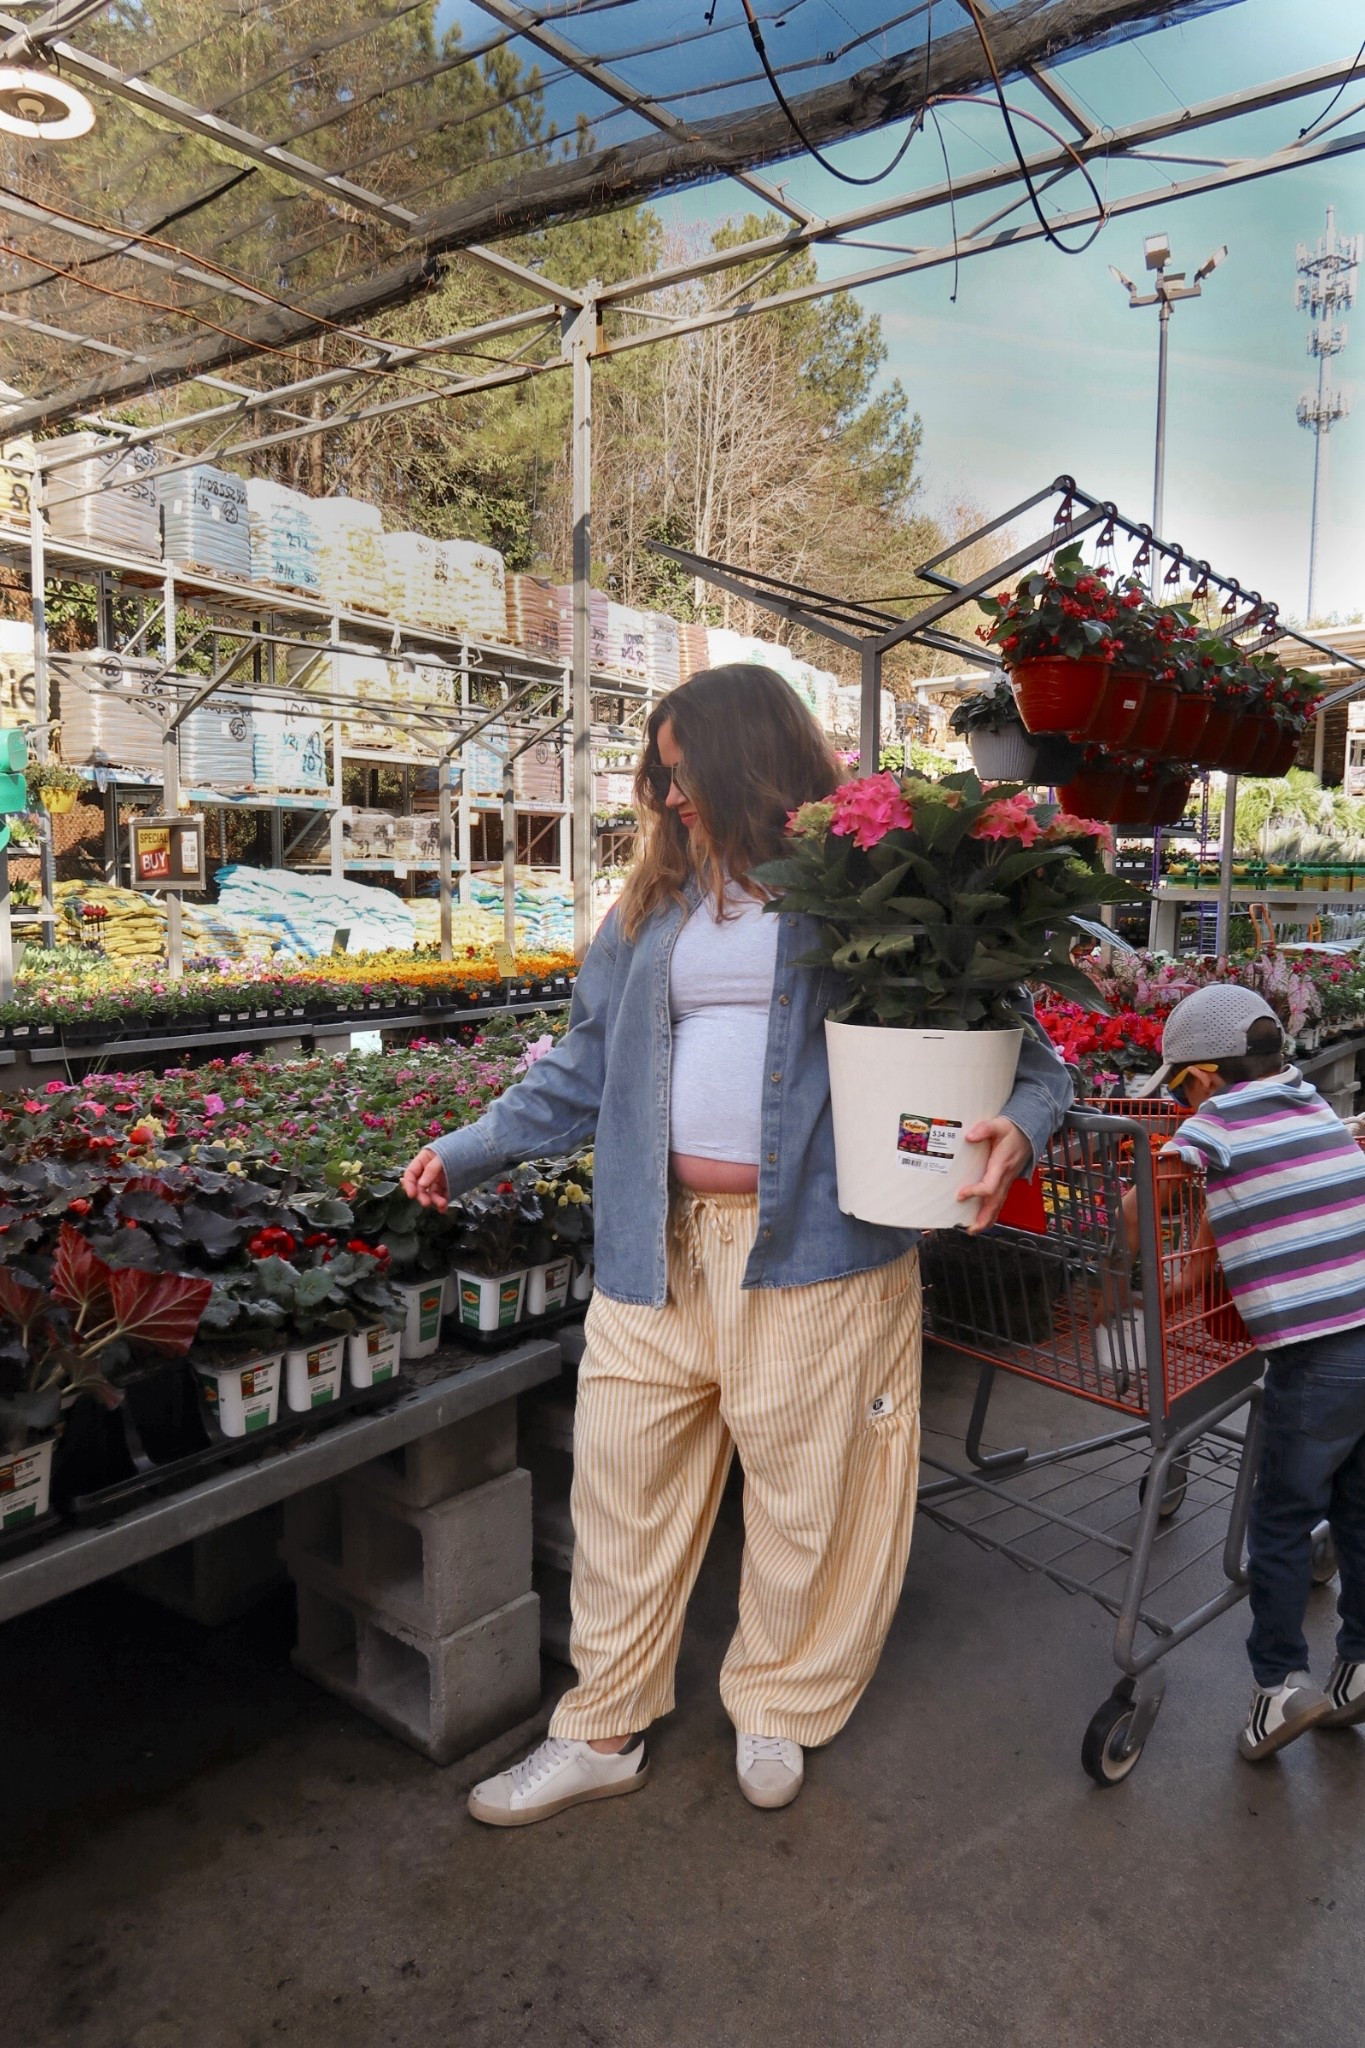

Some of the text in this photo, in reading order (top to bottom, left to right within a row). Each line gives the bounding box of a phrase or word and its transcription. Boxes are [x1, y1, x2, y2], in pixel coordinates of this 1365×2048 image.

[140, 832, 168, 844] SPECIAL
[142, 850, 166, 871] BUY
[932, 1130, 956, 1139] $34.98
